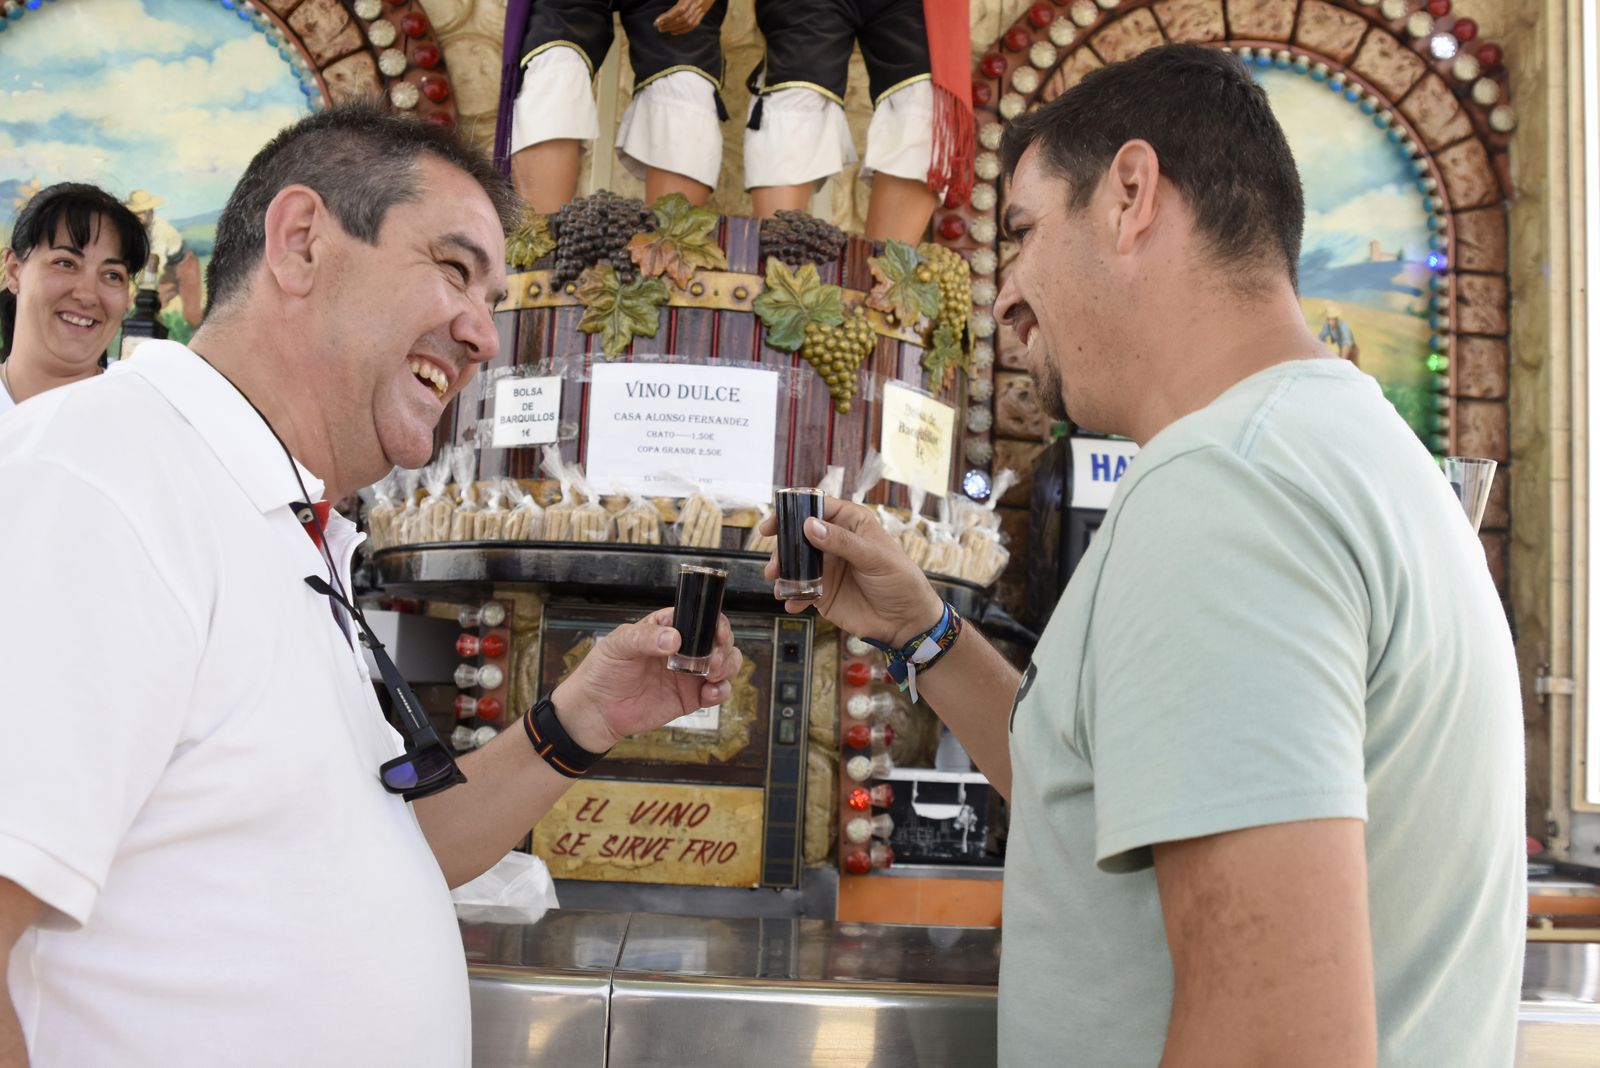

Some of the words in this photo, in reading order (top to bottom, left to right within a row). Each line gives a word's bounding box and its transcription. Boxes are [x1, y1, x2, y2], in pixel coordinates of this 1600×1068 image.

[513, 387, 543, 397] BOLSA
[625, 380, 671, 399] VINO
[677, 384, 741, 403] DULCE
[521, 402, 534, 411] DE
[500, 412, 555, 424] BARQUILLOS
[614, 412, 642, 422] CASA
[645, 413, 686, 423] ALONSO
[688, 414, 750, 427] FERNANDEZ
[522, 428, 531, 437] 1€
[637, 445, 660, 454] COPA
[661, 446, 697, 456] GRANDE
[1090, 453, 1136, 482] HA
[575, 797, 611, 823] EL
[628, 800, 711, 829] VINO
[551, 832, 592, 857] SE
[598, 834, 676, 863] SIRVE
[678, 838, 738, 867] FRIO
